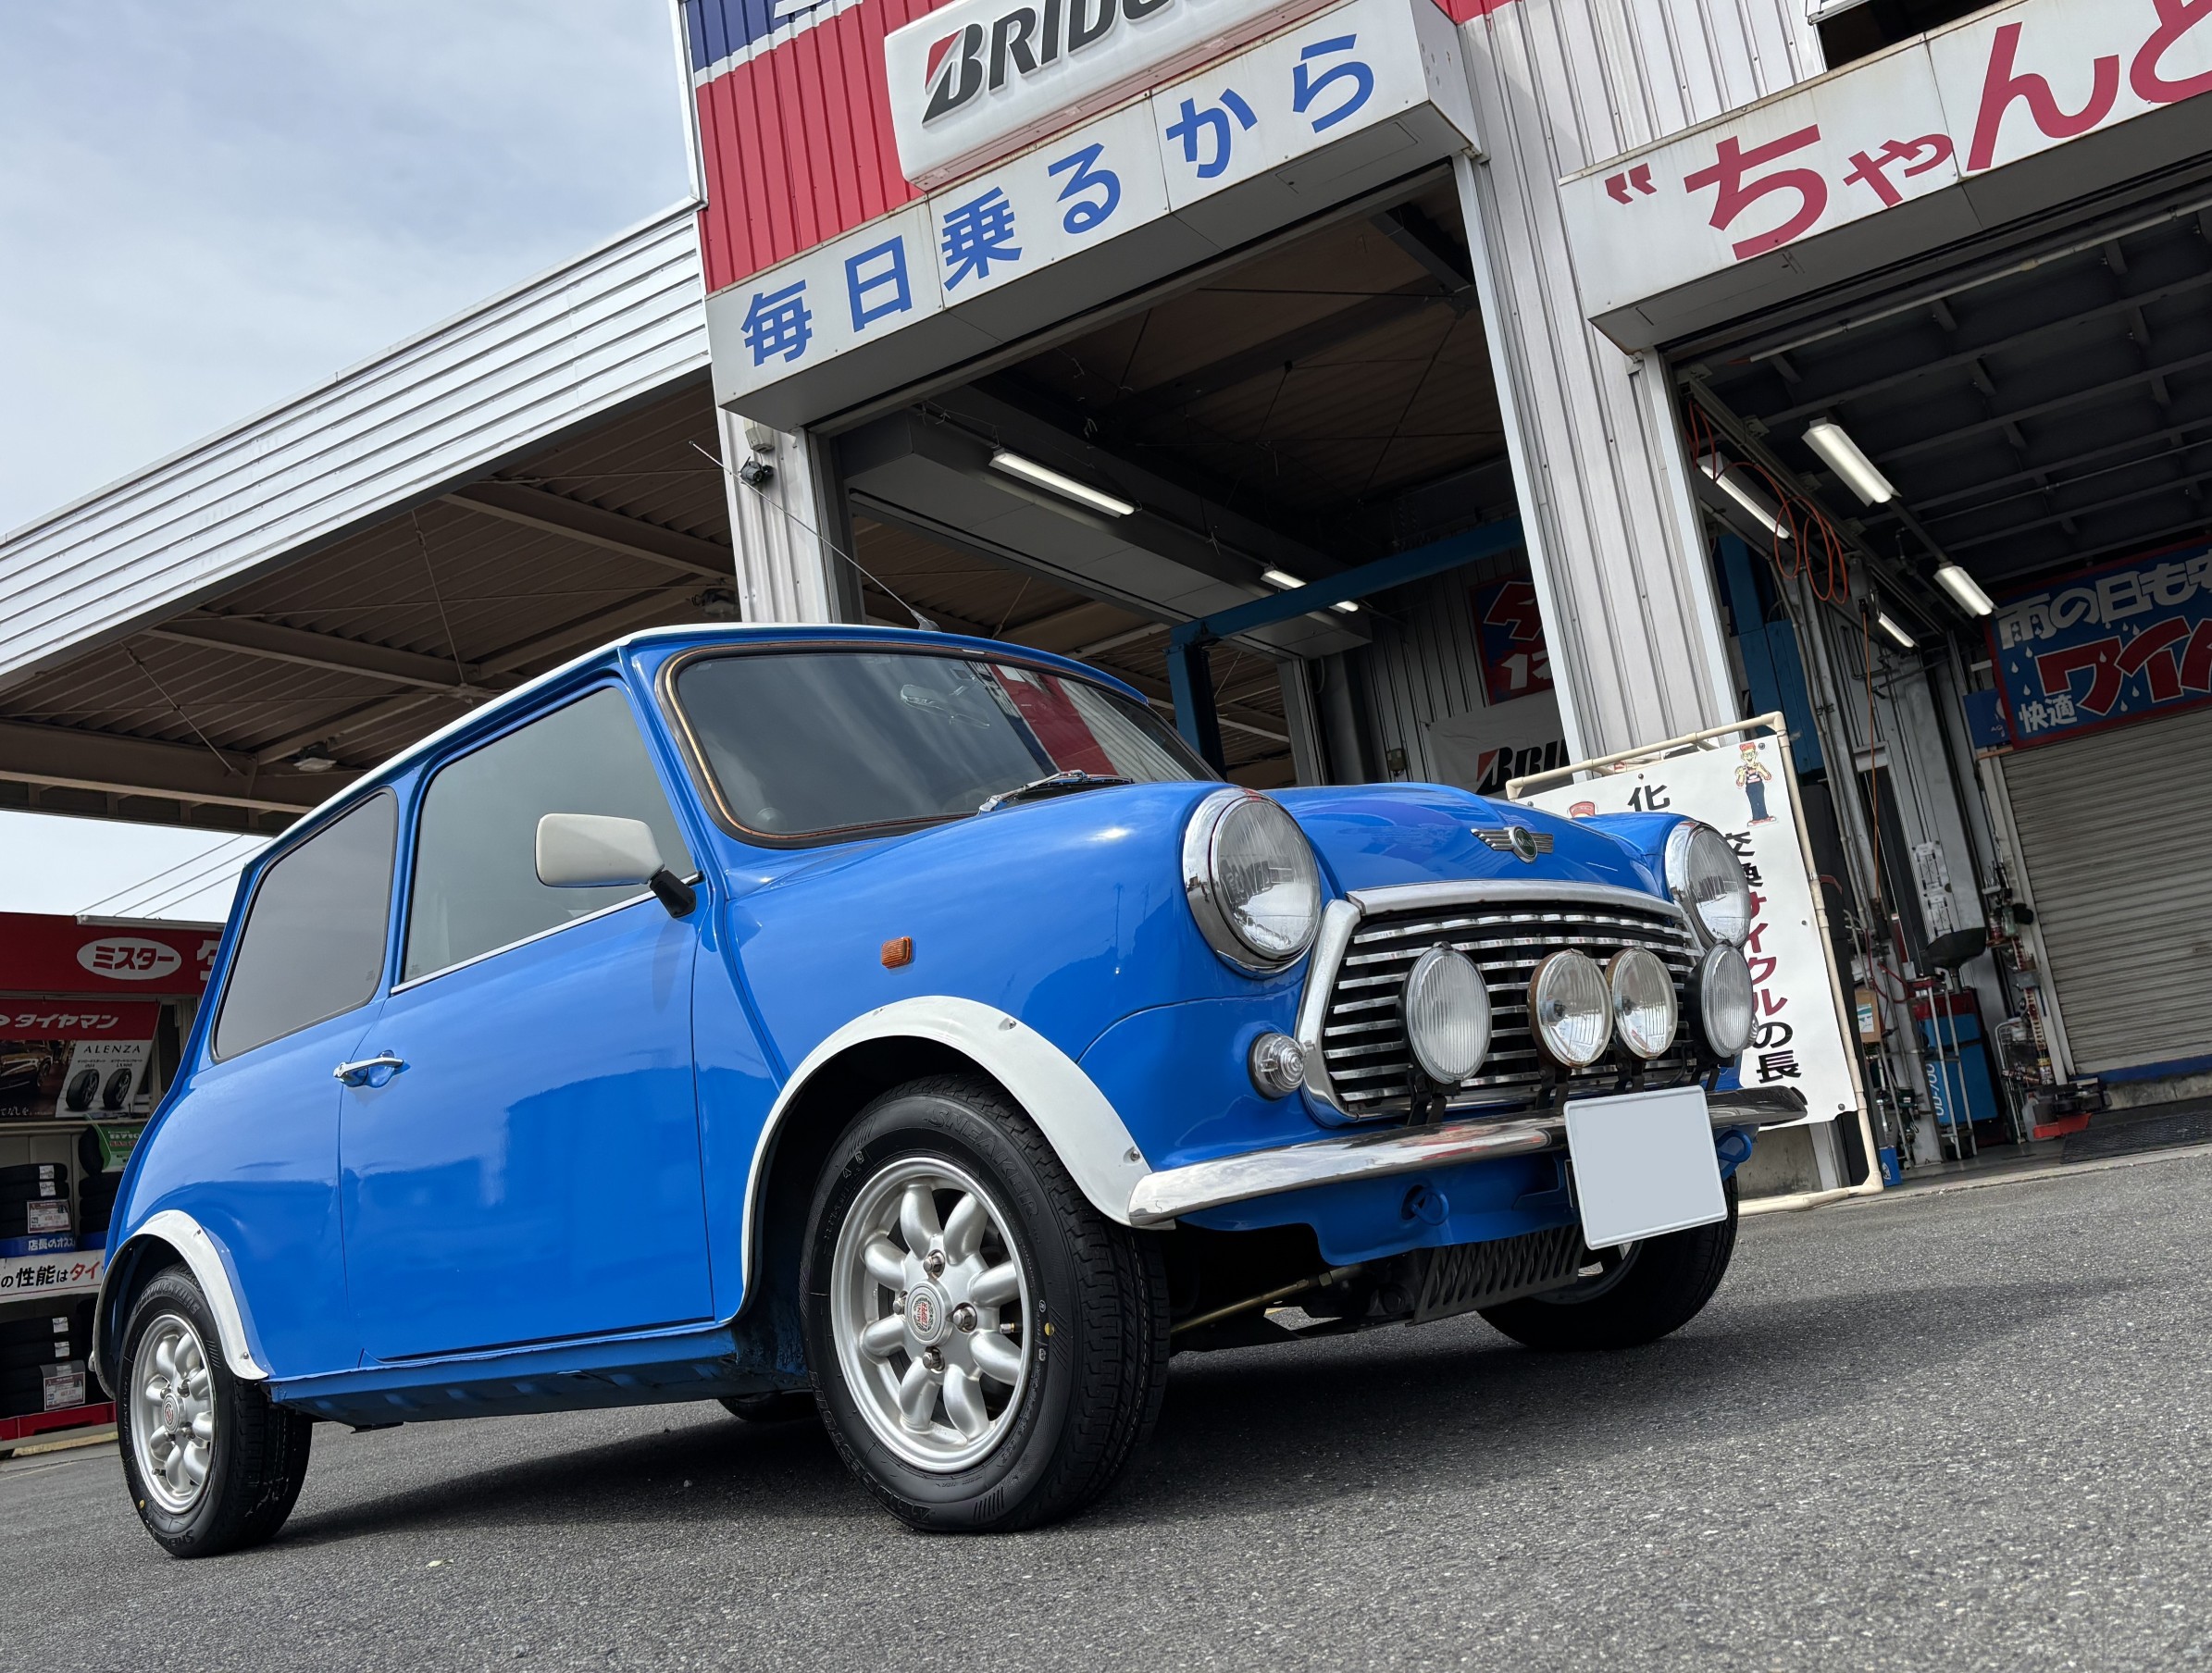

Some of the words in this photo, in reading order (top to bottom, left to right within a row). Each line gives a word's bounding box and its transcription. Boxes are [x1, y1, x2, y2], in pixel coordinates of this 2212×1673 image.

[922, 0, 1169, 124] BRID
[740, 34, 1376, 367] 毎日乗るから
[2019, 694, 2078, 734] 快適
[1475, 738, 1572, 796] BRI
[93, 945, 175, 971] ミスター
[15, 1013, 119, 1029] タイヤマン
[83, 1045, 141, 1054] ALENZA
[927, 1107, 1039, 1221] SNEAKER
[28, 1236, 75, 1252] 店長のオスス
[1, 1261, 104, 1288] の性能はタイ
